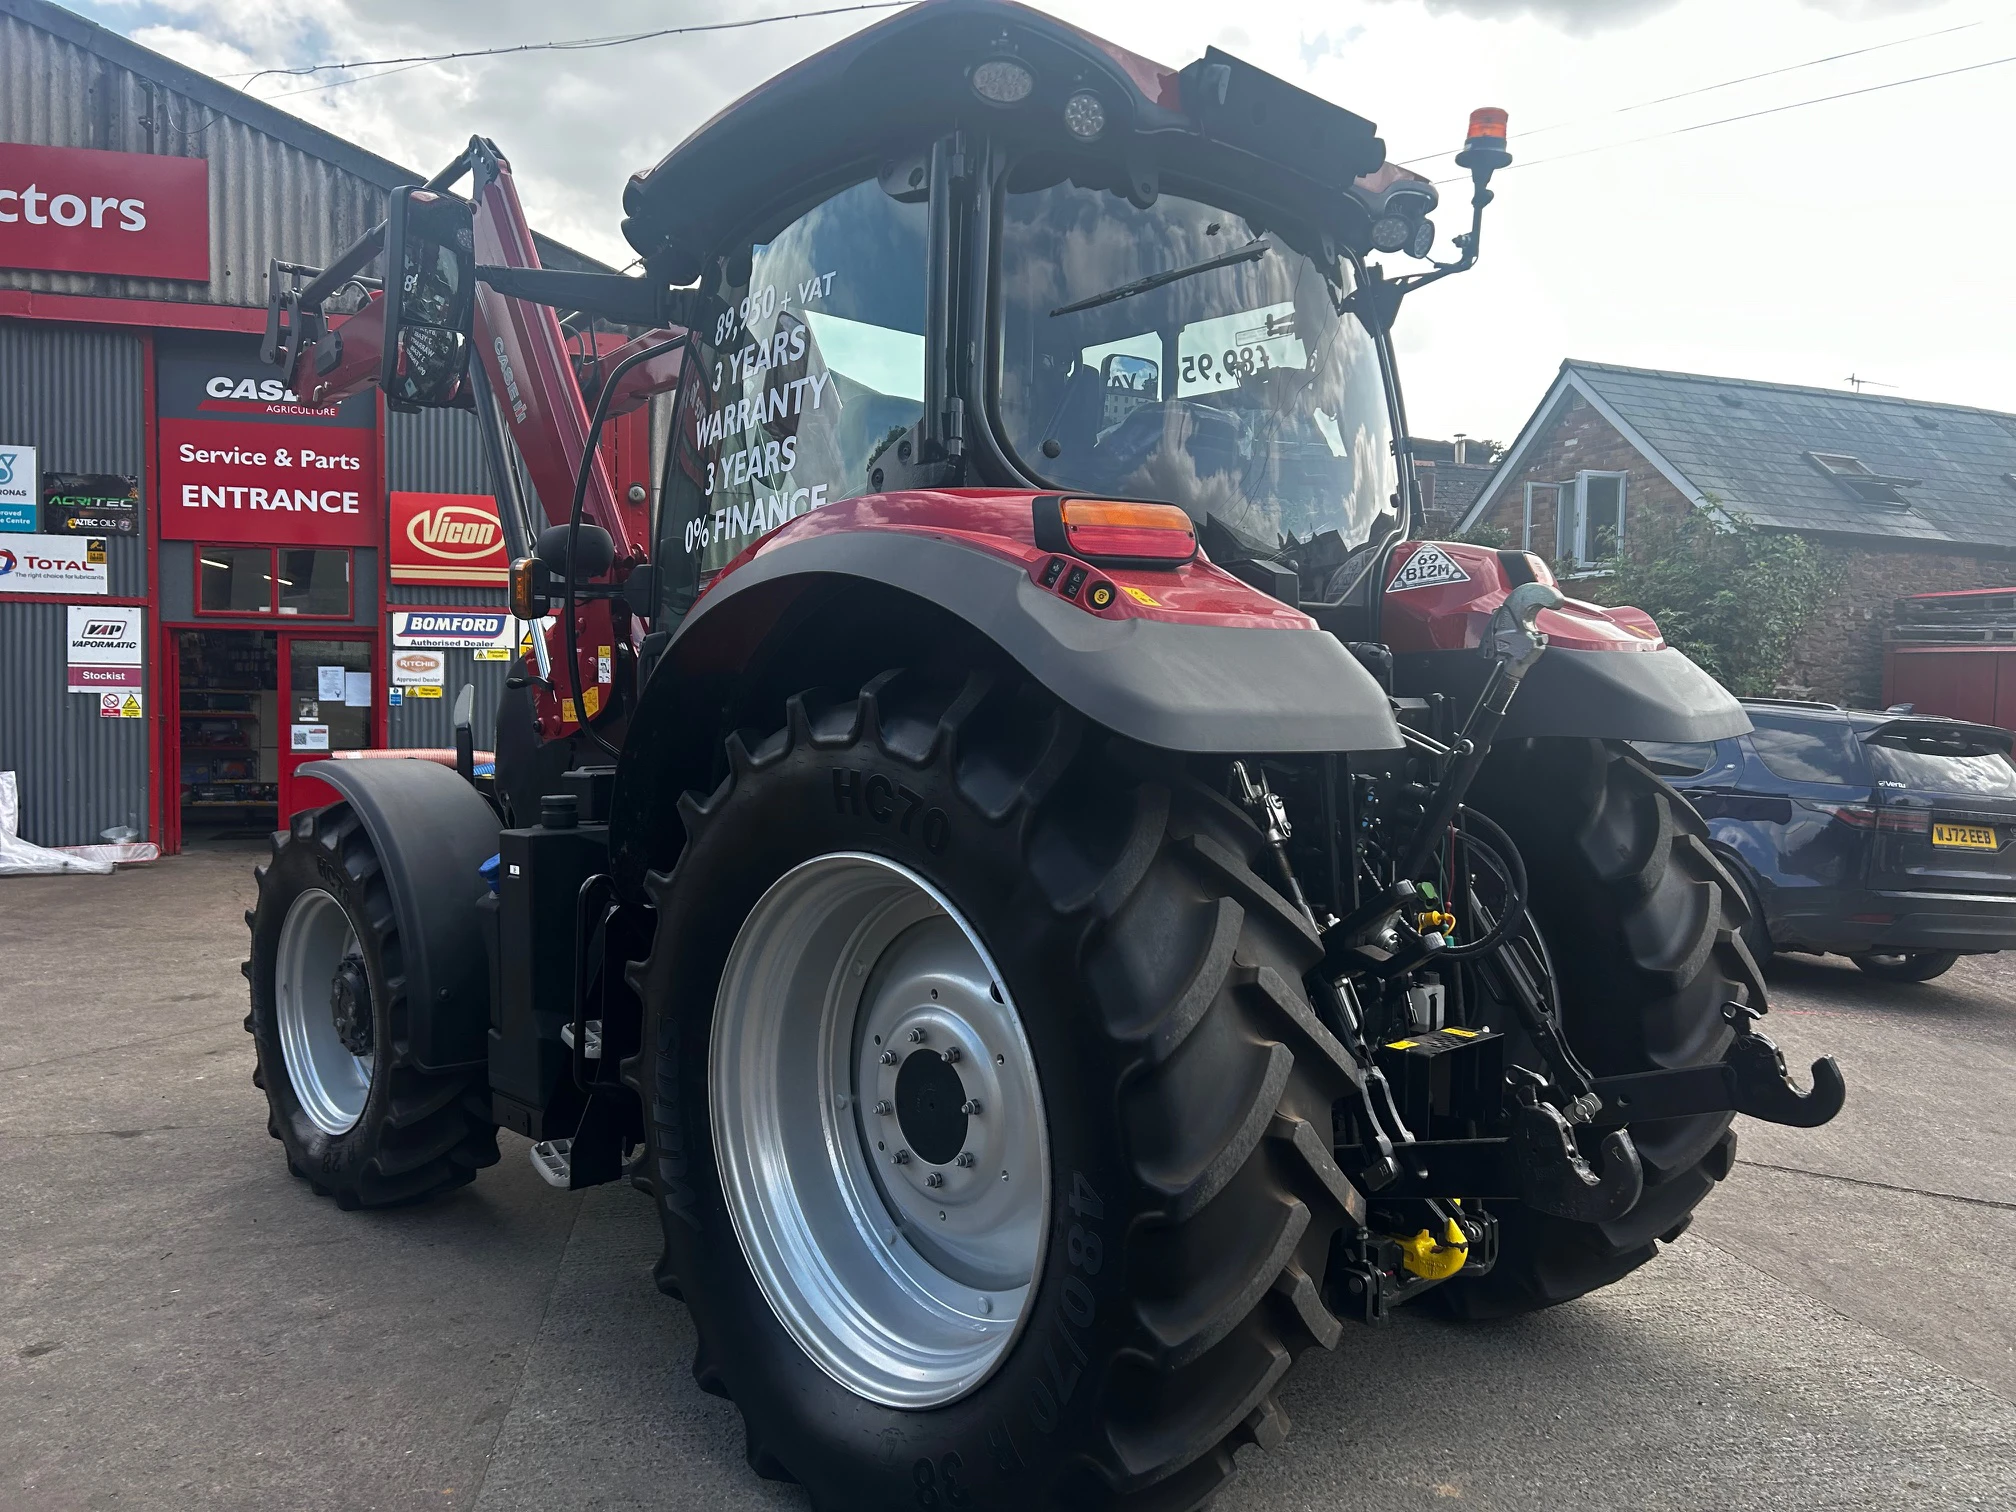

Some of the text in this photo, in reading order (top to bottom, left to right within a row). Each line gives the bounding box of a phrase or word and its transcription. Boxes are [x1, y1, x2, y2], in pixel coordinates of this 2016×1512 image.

[0, 184, 146, 231] ctors
[715, 271, 836, 346] 89,950 + VAT
[494, 336, 519, 402] CASE
[712, 324, 806, 392] 3 YEARS
[697, 371, 830, 450] WARRANTY
[179, 443, 361, 470] Service & Parts
[704, 435, 797, 496] 3 YEARS
[49, 495, 133, 508] AGRITEC
[182, 484, 360, 514] ENTRANCE
[5, 517, 31, 525] Centre
[75, 518, 98, 527] AZTEC
[99, 519, 116, 527] OILS
[423, 509, 495, 545] Vicon
[685, 484, 827, 553] 0% FINANCE
[23, 556, 95, 571] TOTAL
[1417, 553, 1439, 565] 69
[87, 624, 122, 636] VAP
[410, 617, 499, 632] BOMFORD
[72, 640, 137, 649] VAPORMATIC
[410, 639, 494, 648] Authorised Dealer
[400, 659, 436, 668] RITCHIE
[82, 671, 126, 681] Stockist
[832, 767, 950, 856] HC70
[1935, 826, 1991, 845] WJ72 EEB
[1028, 1170, 1104, 1434] 480/70
